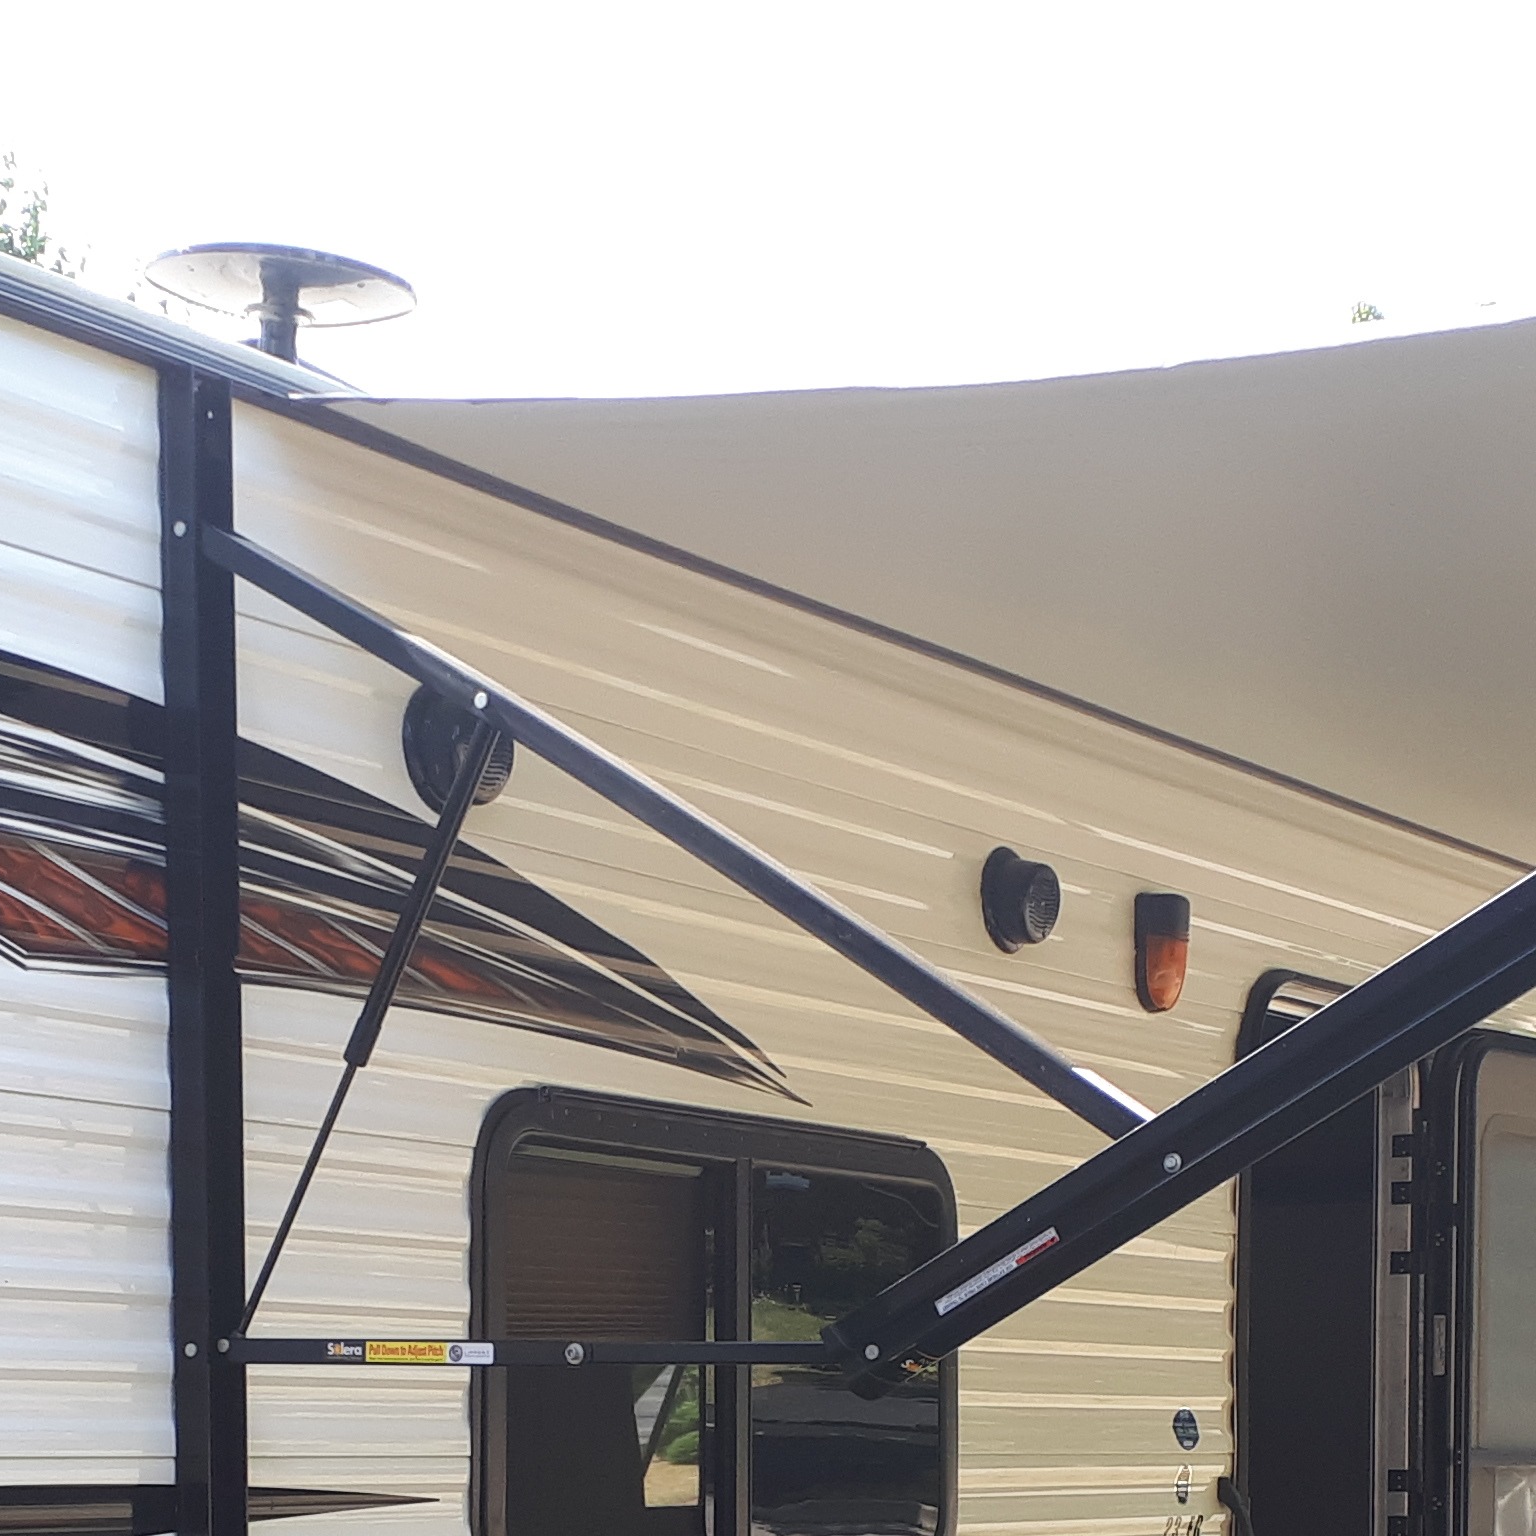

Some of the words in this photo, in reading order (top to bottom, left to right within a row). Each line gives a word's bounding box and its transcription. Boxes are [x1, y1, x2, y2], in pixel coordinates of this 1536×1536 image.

[327, 1342, 362, 1356] Solera
[368, 1343, 381, 1356] Pull
[381, 1344, 400, 1356] Down
[400, 1344, 407, 1355] to
[407, 1344, 427, 1359] Adjust
[427, 1344, 444, 1357] Pitch
